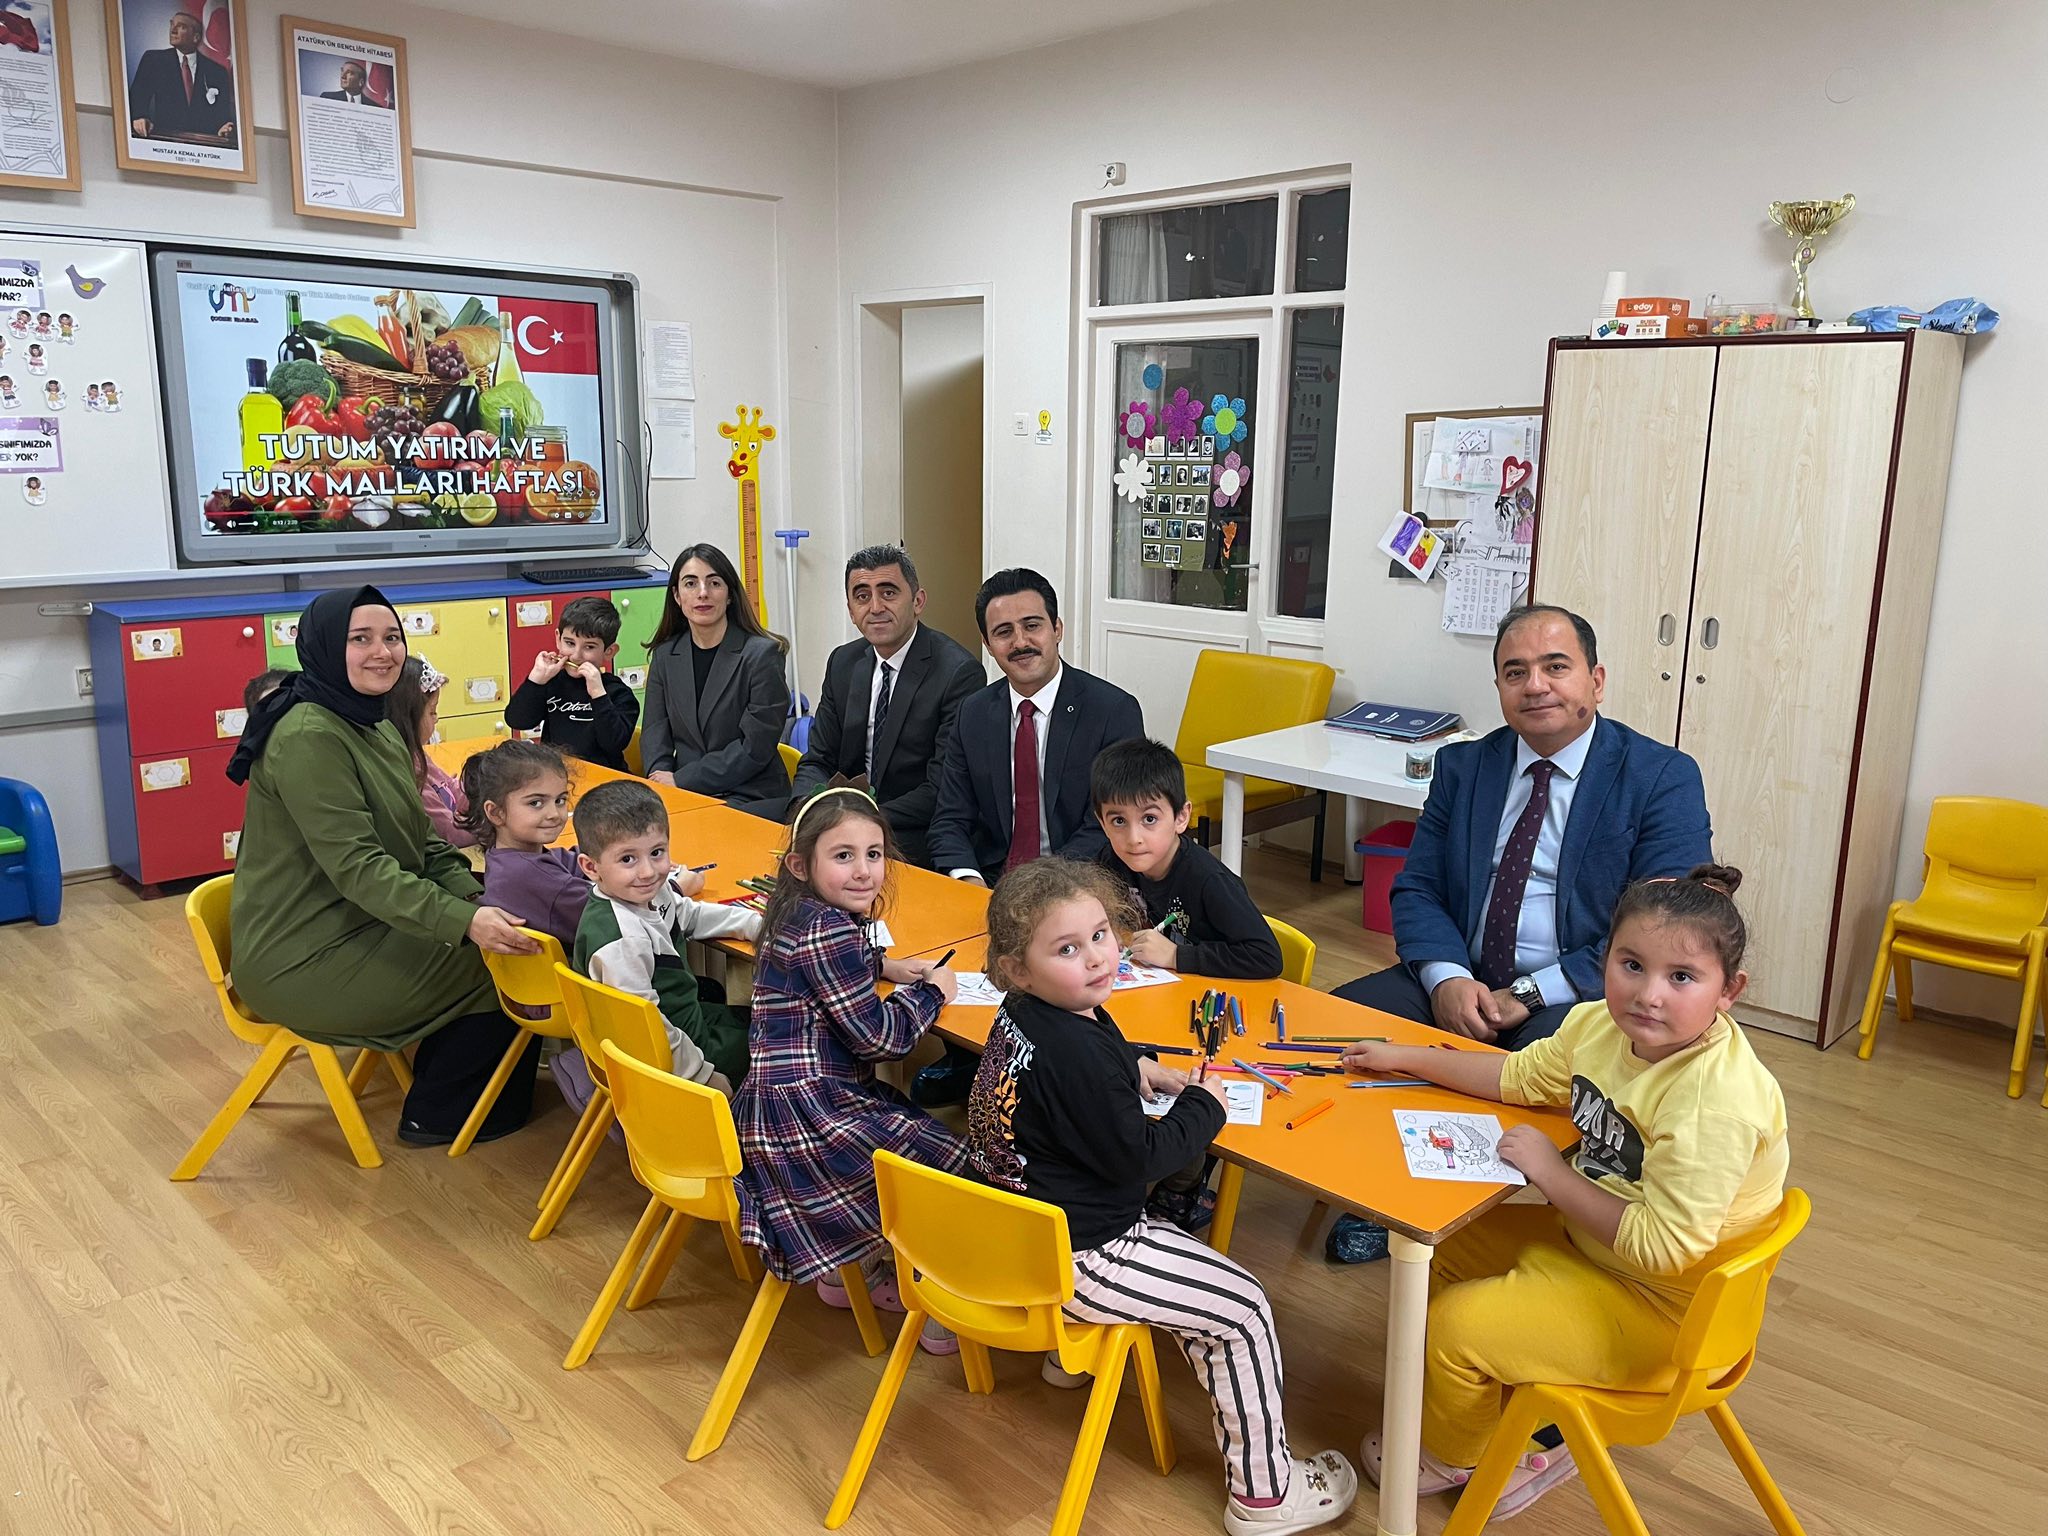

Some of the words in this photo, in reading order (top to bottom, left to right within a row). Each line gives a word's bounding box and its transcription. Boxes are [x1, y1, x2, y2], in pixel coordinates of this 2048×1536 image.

[152, 147, 178, 155] MUSTAFA
[197, 152, 221, 160] ATATÜRK
[15, 453, 38, 461] YOK?
[258, 434, 378, 460] TUTUM
[386, 435, 501, 461] YATIRIM
[509, 436, 546, 460] VE
[223, 466, 315, 498] TÜRK
[326, 470, 463, 496] MALLARI
[472, 470, 584, 494] HAFTASI
